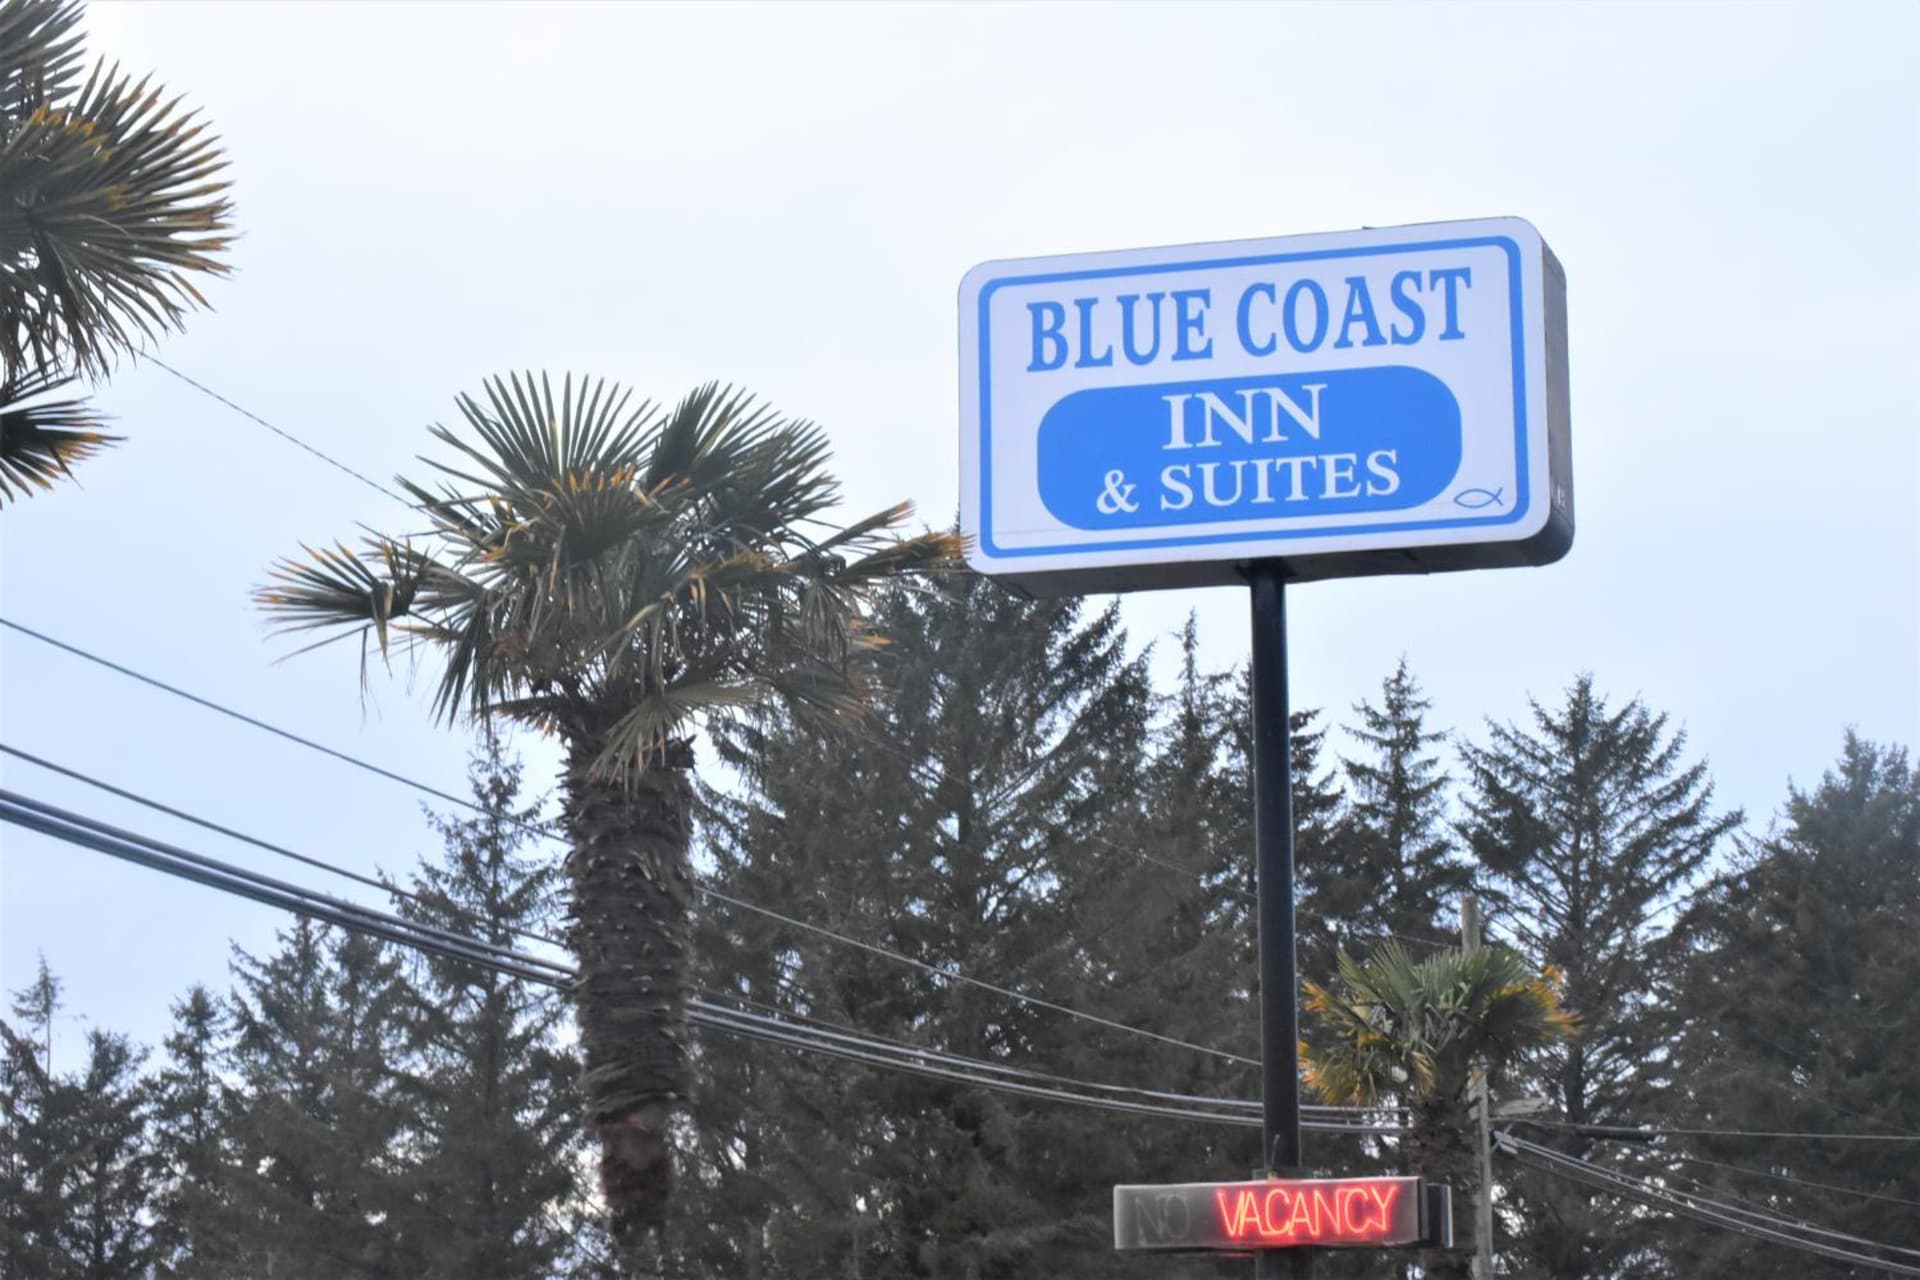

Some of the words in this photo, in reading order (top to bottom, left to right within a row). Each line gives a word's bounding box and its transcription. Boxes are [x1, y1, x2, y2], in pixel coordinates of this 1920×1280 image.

[1026, 287, 1213, 373] BLUE
[1236, 266, 1472, 358] COAST
[1162, 383, 1328, 451] INN
[1096, 469, 1140, 515] &
[1160, 449, 1400, 512] SUITES
[1135, 1195, 1191, 1245] NO
[1216, 1185, 1397, 1237] VACANCY
